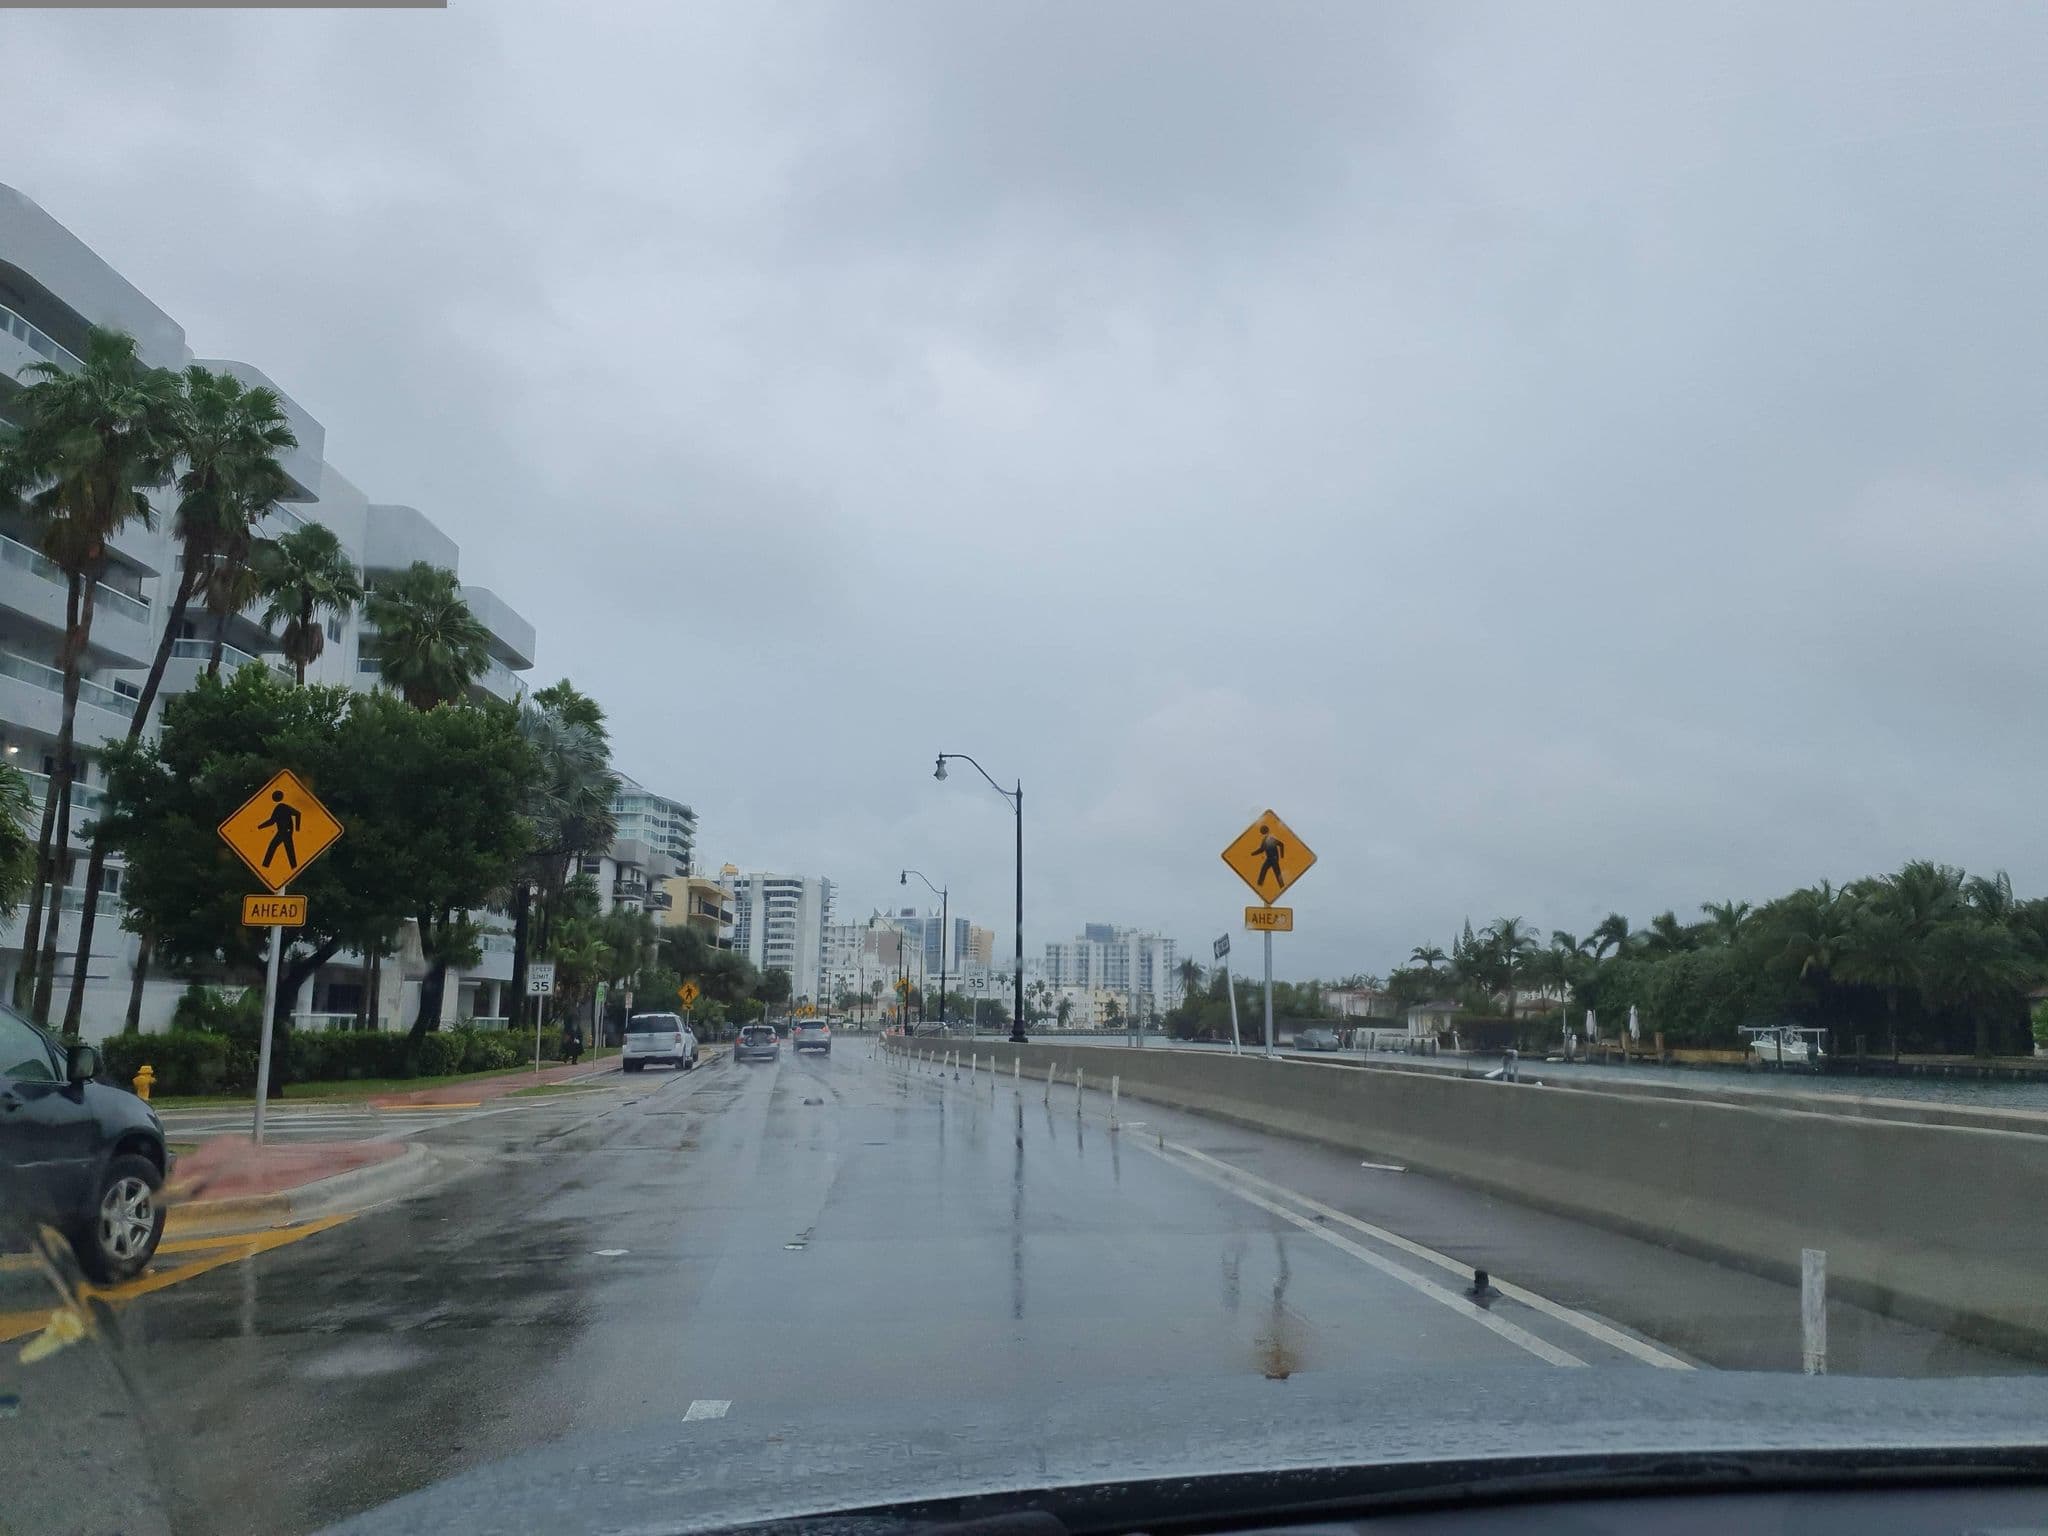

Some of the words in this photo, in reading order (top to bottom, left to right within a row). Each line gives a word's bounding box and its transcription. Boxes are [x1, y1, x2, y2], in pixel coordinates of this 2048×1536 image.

[252, 904, 297, 917] AHEAD
[532, 981, 549, 991] 35
[969, 978, 984, 988] 35
